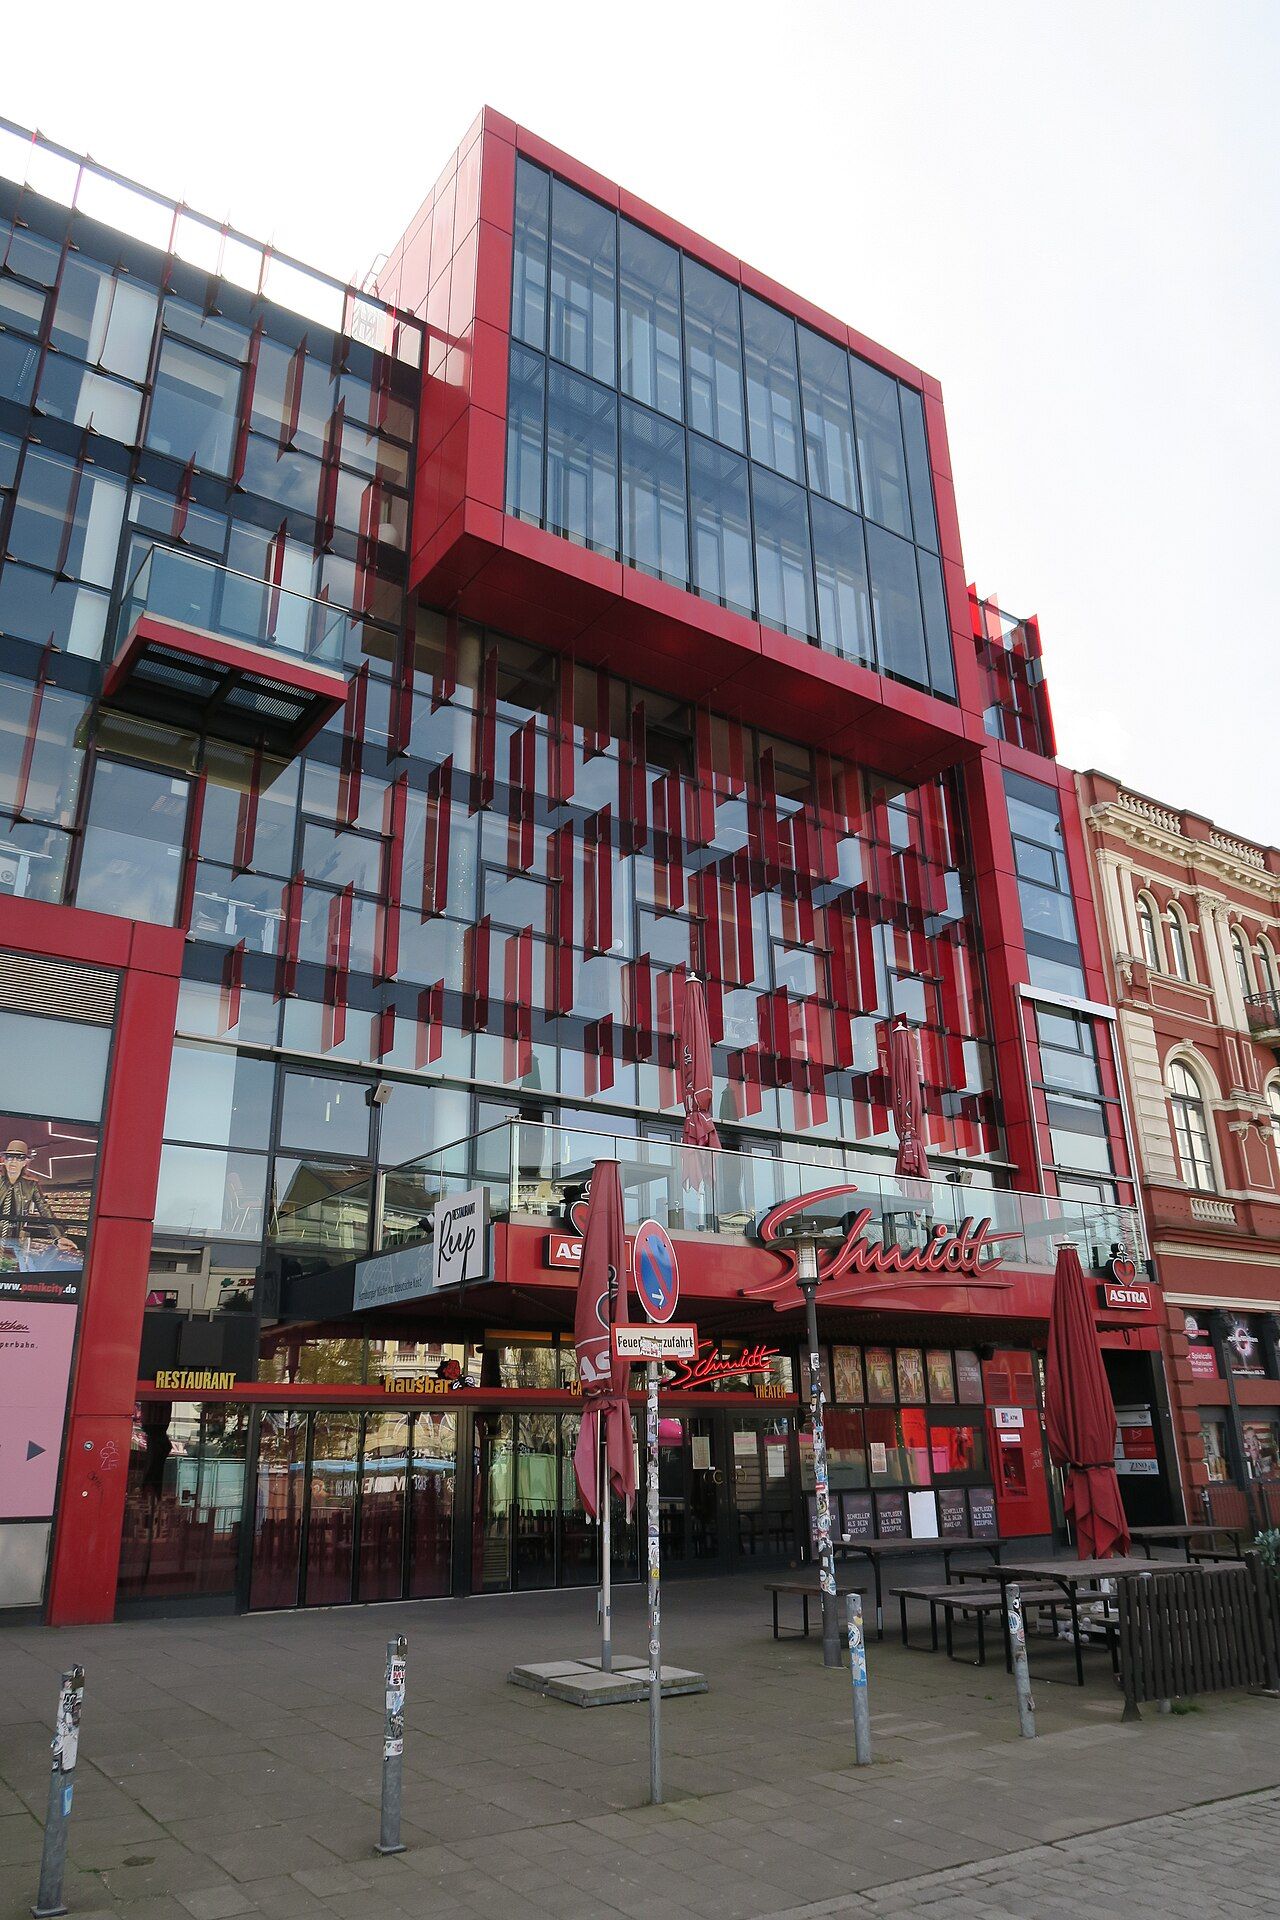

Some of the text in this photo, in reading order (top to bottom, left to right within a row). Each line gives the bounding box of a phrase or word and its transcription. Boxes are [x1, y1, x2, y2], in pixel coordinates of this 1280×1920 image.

[452, 1202, 476, 1220] RESTAURANT
[1110, 1289, 1148, 1304] ASTRA
[617, 1335, 693, 1348] Feuerzufahrt
[155, 1370, 236, 1390] RESTAURANT
[384, 1374, 452, 1394] hausbar
[754, 1384, 787, 1399] THEATER
[846, 1512, 871, 1520] SCHRILLER
[847, 1519, 869, 1528] ALS DEIN
